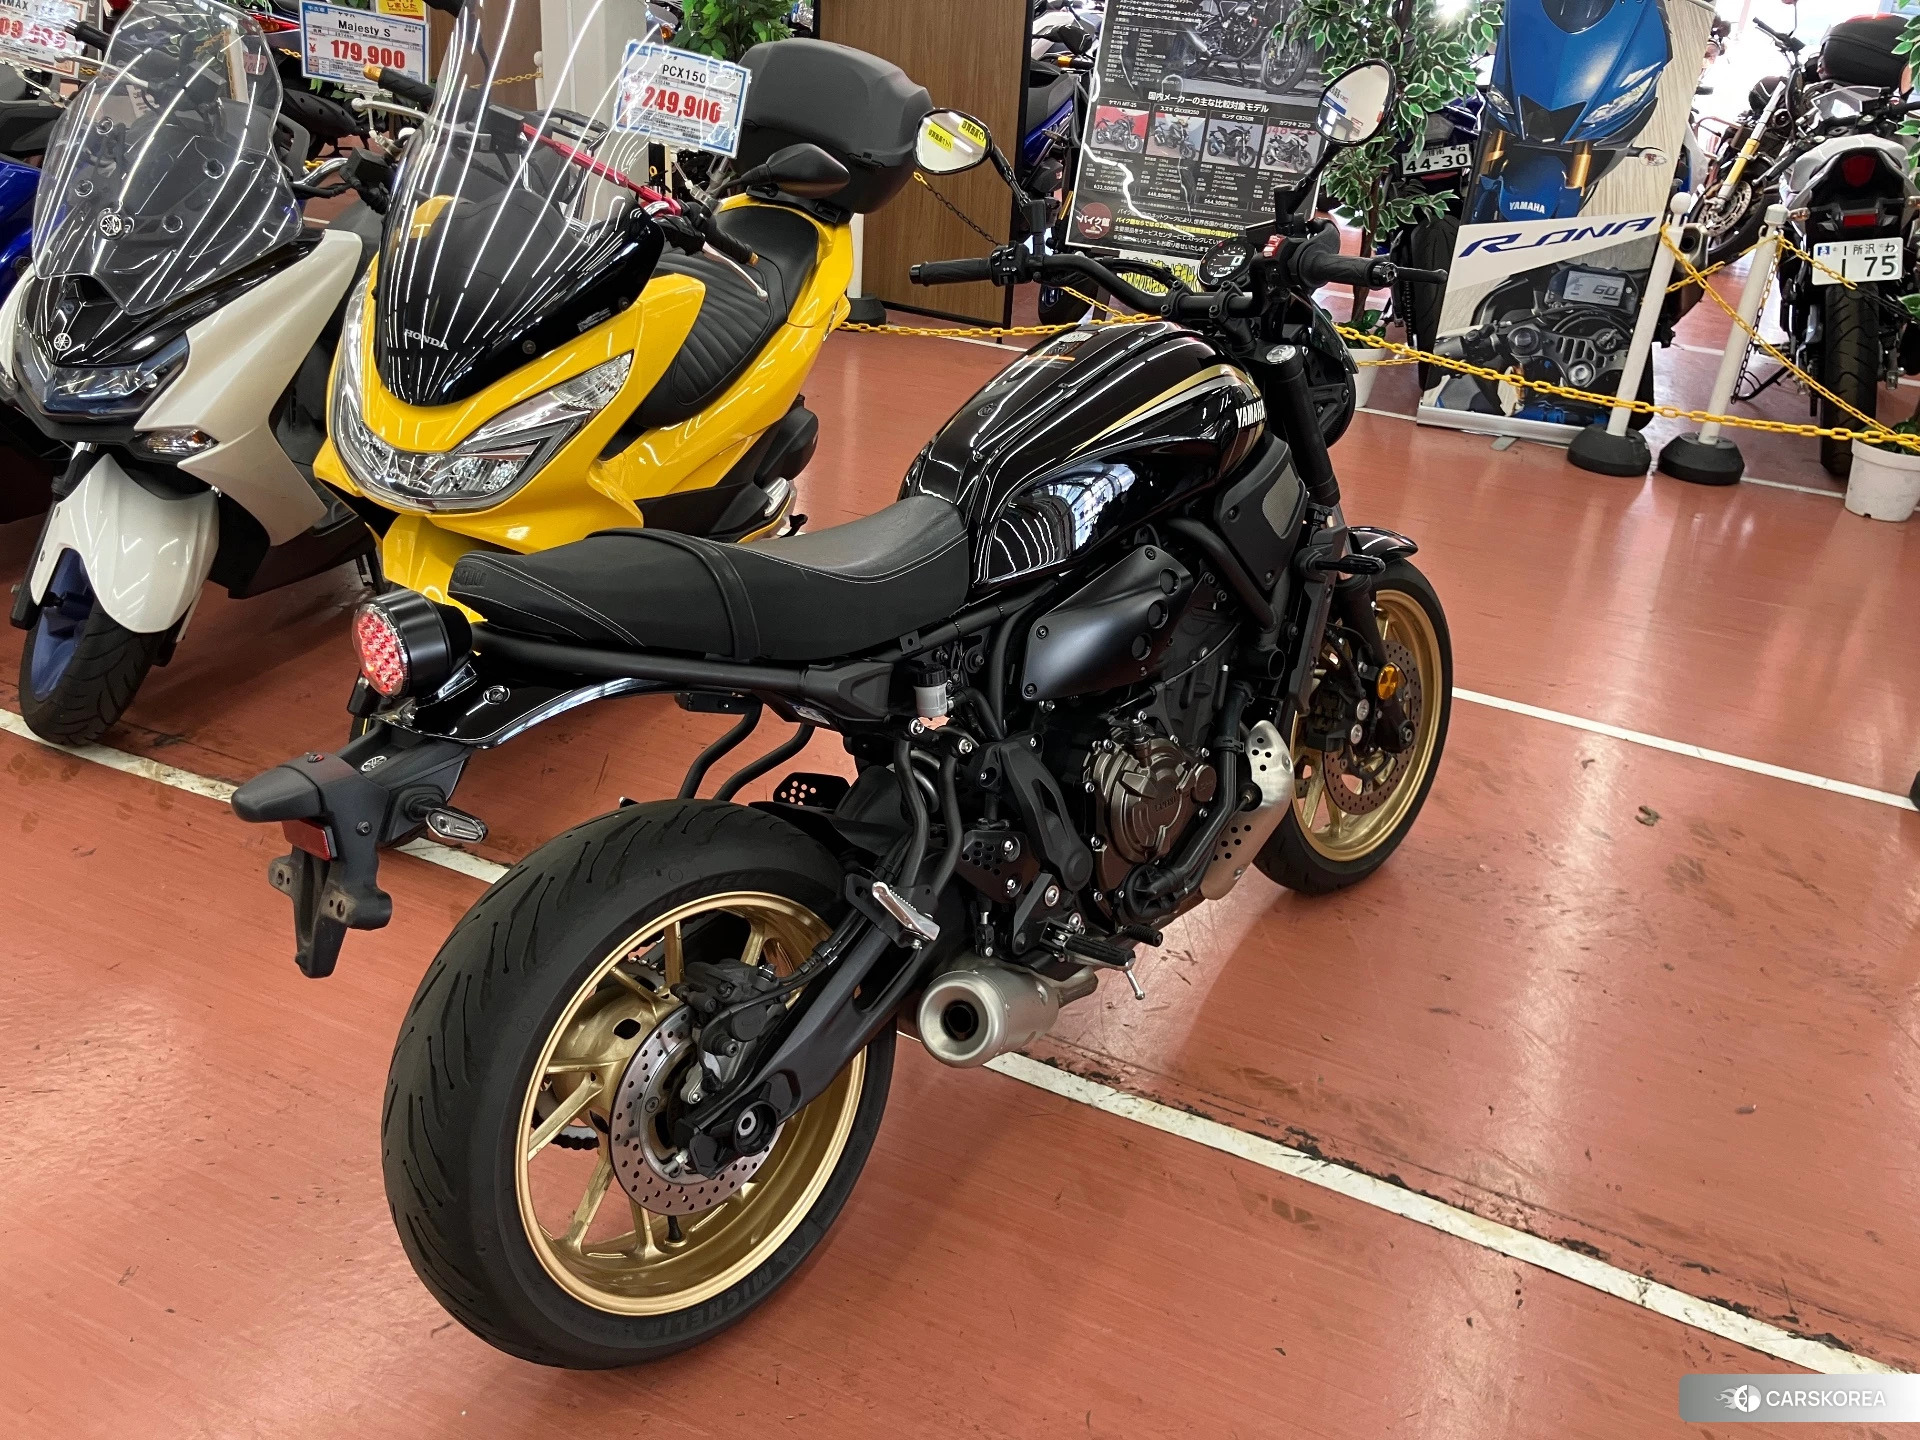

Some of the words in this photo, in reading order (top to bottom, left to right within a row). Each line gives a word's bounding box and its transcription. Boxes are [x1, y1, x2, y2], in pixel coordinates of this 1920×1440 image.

[338, 20, 380, 35] Majesty
[384, 28, 391, 37] S
[331, 39, 405, 69] 179,900
[662, 64, 707, 83] PCX150
[641, 86, 722, 124] 249,900
[1147, 91, 1270, 113] 国内メーカーの主な比較対象モデル
[1405, 153, 1468, 173] 44-30
[1509, 201, 1546, 214] YAMAHA
[1852, 243, 1876, 256] 所沢
[1884, 242, 1896, 253] わ
[1592, 284, 1619, 296] 60
[404, 328, 450, 351] HONDA
[1235, 398, 1267, 429] YAMAHA
